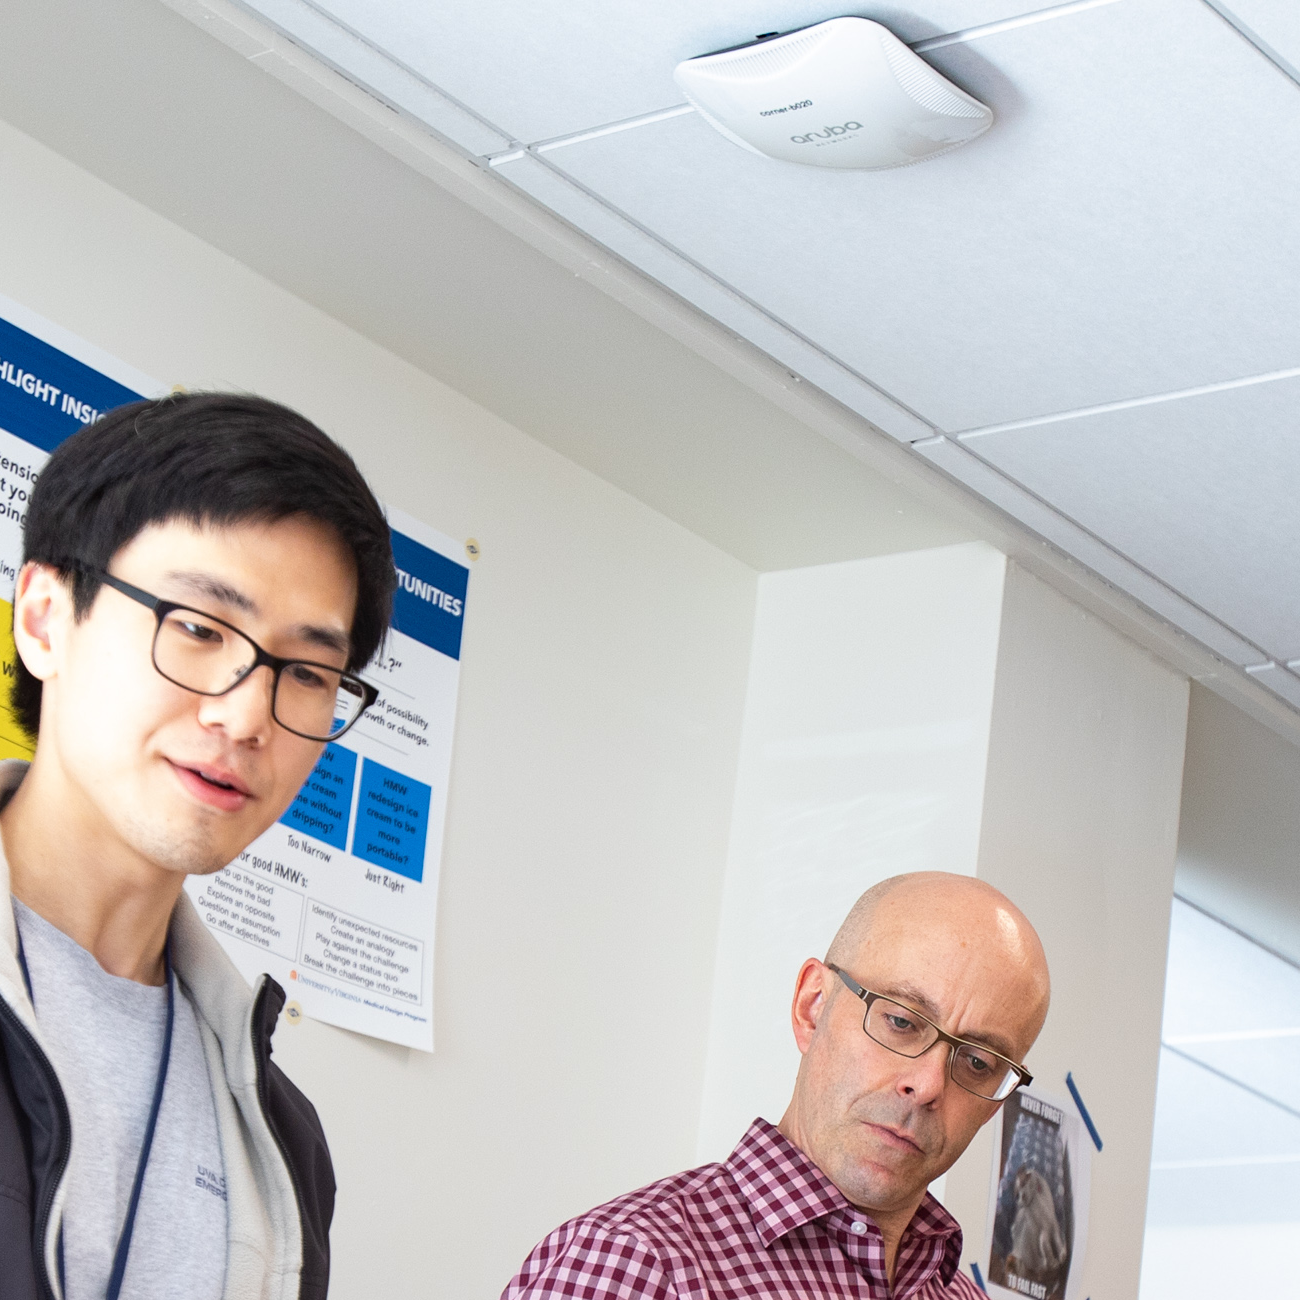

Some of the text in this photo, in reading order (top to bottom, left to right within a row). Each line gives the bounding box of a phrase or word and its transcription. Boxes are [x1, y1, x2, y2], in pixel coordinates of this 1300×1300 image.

[790, 121, 864, 144] aruba
[376, 698, 429, 730] of possibility
[387, 721, 396, 730] or
[397, 726, 430, 747] change.
[311, 782, 337, 800] cream
[333, 775, 344, 785] an
[383, 778, 407, 796] HMW
[310, 800, 342, 820] without
[368, 790, 419, 819] redesign ice
[292, 808, 334, 834] dripping?
[366, 807, 416, 834] cream to be
[288, 834, 332, 863] Too Narrow
[378, 830, 401, 845] more
[252, 856, 272, 873] good
[366, 842, 408, 865] portable?
[215, 875, 271, 907] Remove the bad
[243, 876, 254, 886] the
[255, 883, 274, 895] good
[364, 868, 405, 894] Just Right
[198, 896, 281, 938] Question an assumption
[207, 886, 275, 922] Explore an opposite
[206, 913, 270, 946] Go after adjectives
[312, 904, 418, 952] Identify unexpected resources
[330, 925, 395, 957] Create an analogy
[315, 932, 409, 973] Play against the challenge
[323, 948, 351, 966] Change
[359, 964, 381, 977] status
[384, 972, 398, 983] quo
[304, 954, 418, 1001] Break the challenge into pieces
[1020, 1093, 1064, 1125] NEVER FORGET
